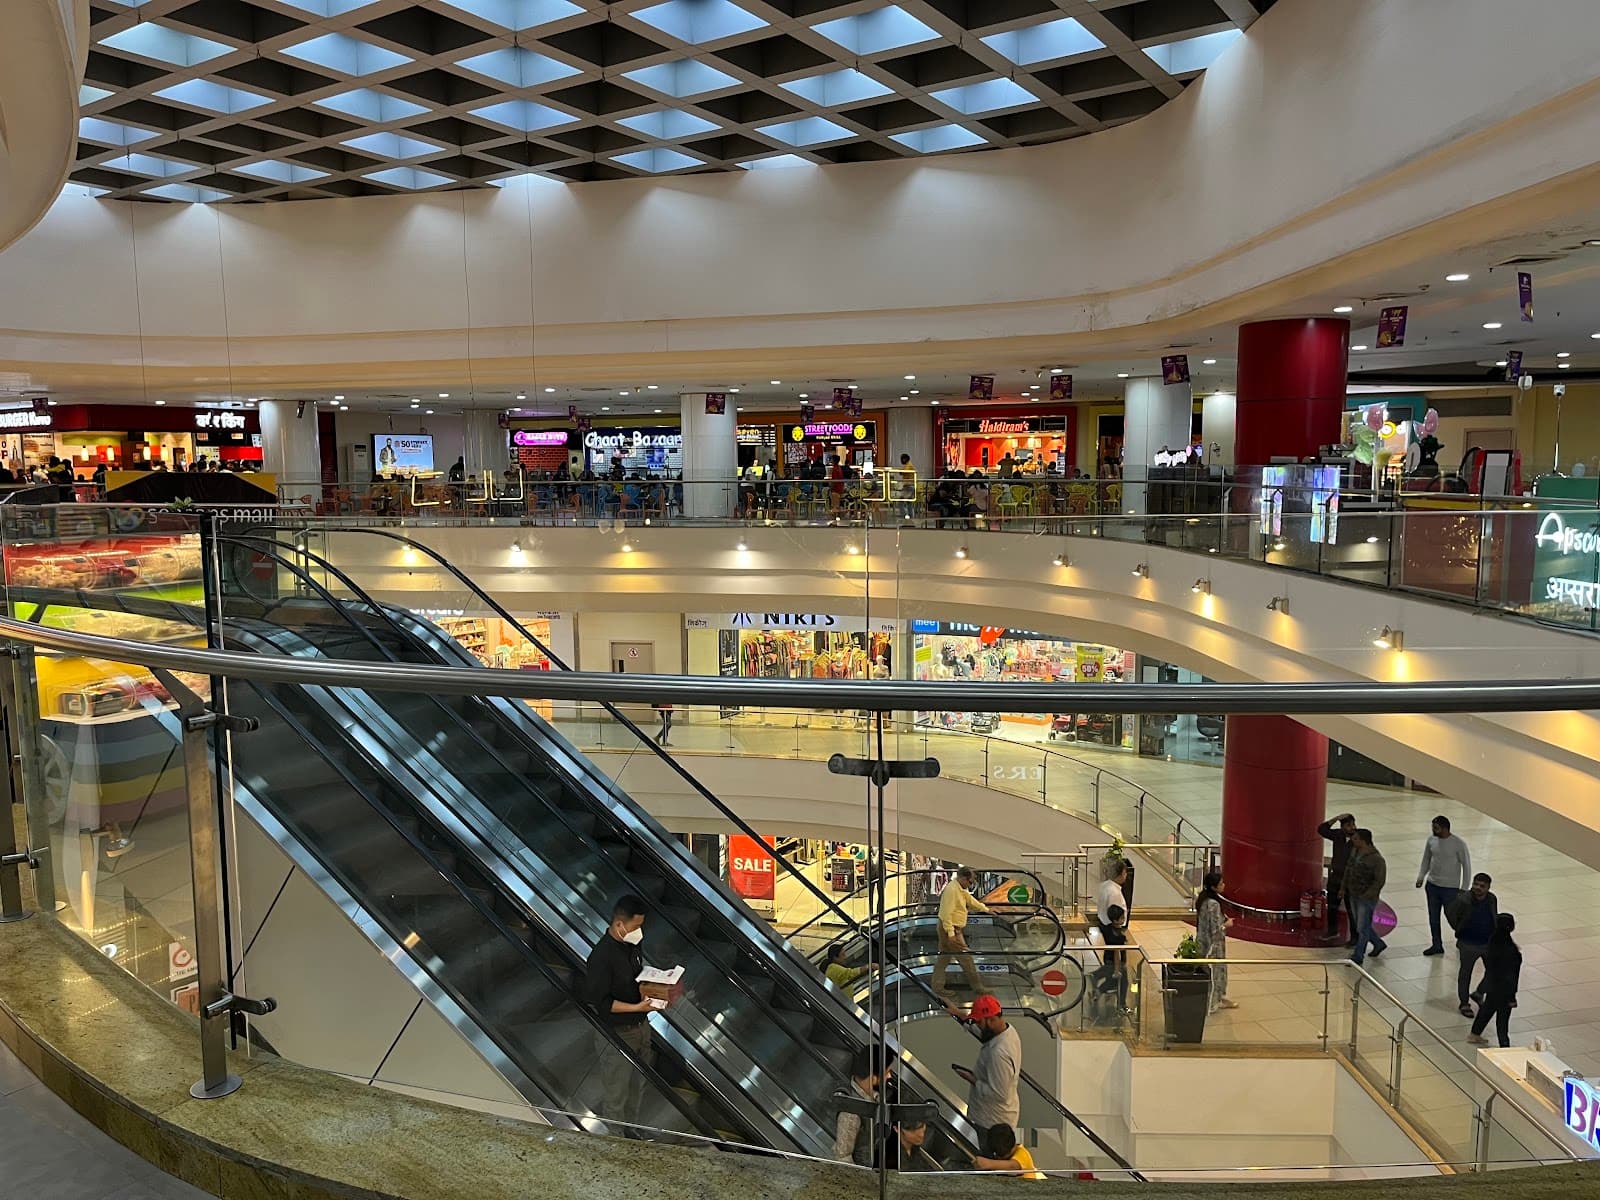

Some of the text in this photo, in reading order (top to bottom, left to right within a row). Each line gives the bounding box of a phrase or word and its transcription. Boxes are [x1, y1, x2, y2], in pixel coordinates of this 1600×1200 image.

[978, 419, 1030, 433] Haldiram's
[585, 431, 625, 447] Chaat
[233, 508, 273, 523] mall
[733, 857, 772, 873] SALE
